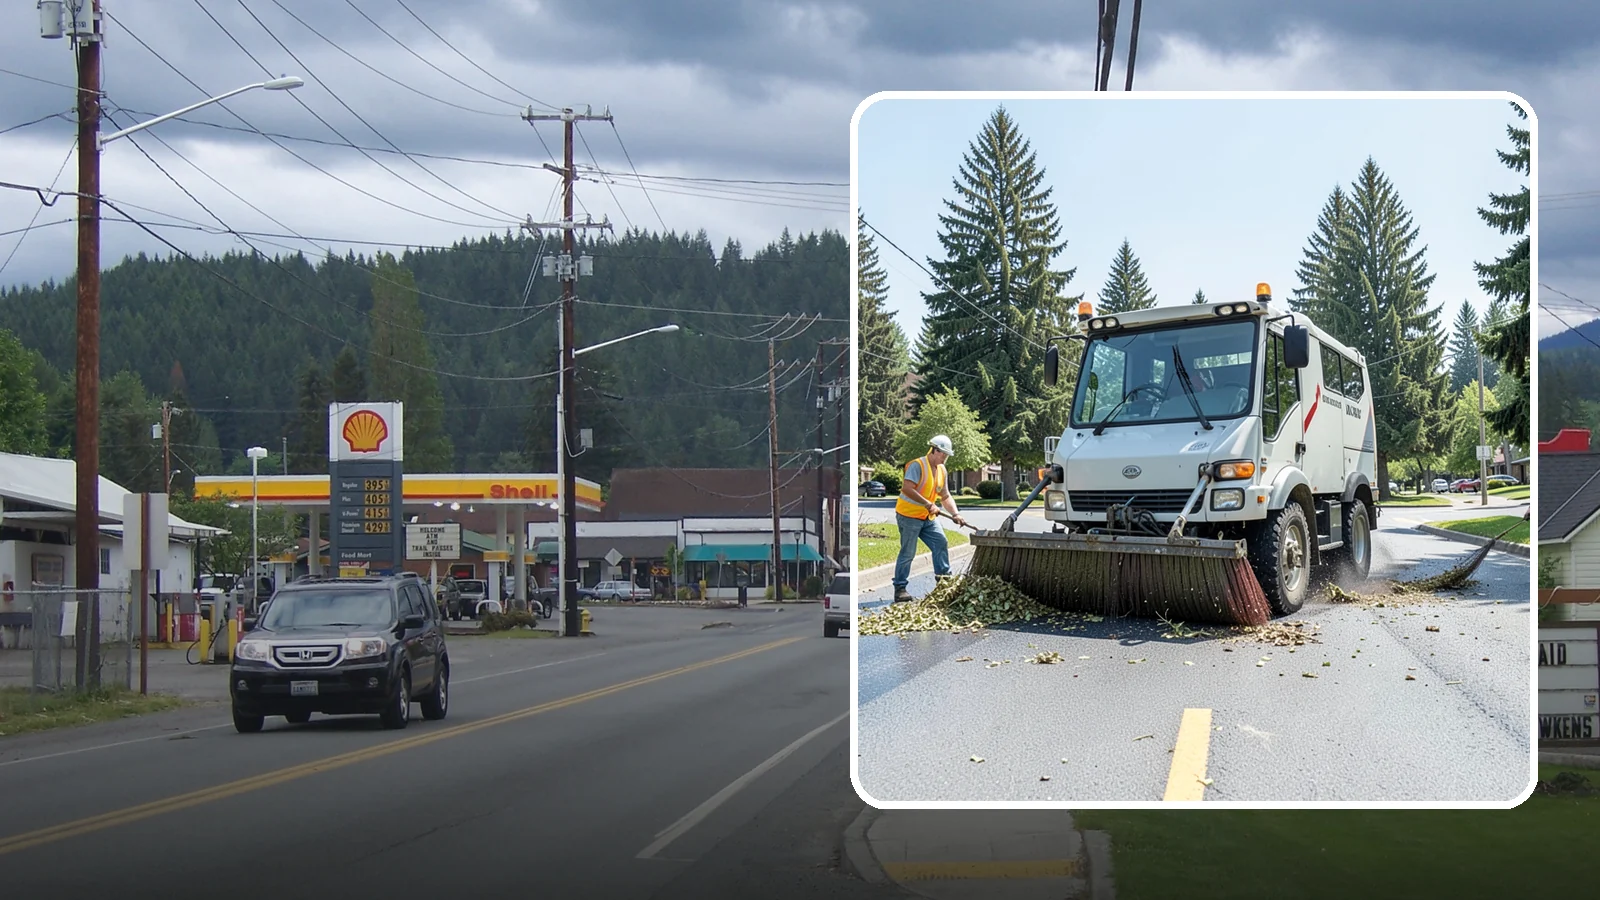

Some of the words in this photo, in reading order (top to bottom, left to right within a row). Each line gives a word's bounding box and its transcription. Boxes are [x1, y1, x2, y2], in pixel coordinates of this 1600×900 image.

[365, 480, 384, 490] 395
[489, 484, 548, 499] Shell
[365, 494, 384, 504] 405
[365, 508, 384, 518] 415
[365, 522, 384, 533] 429
